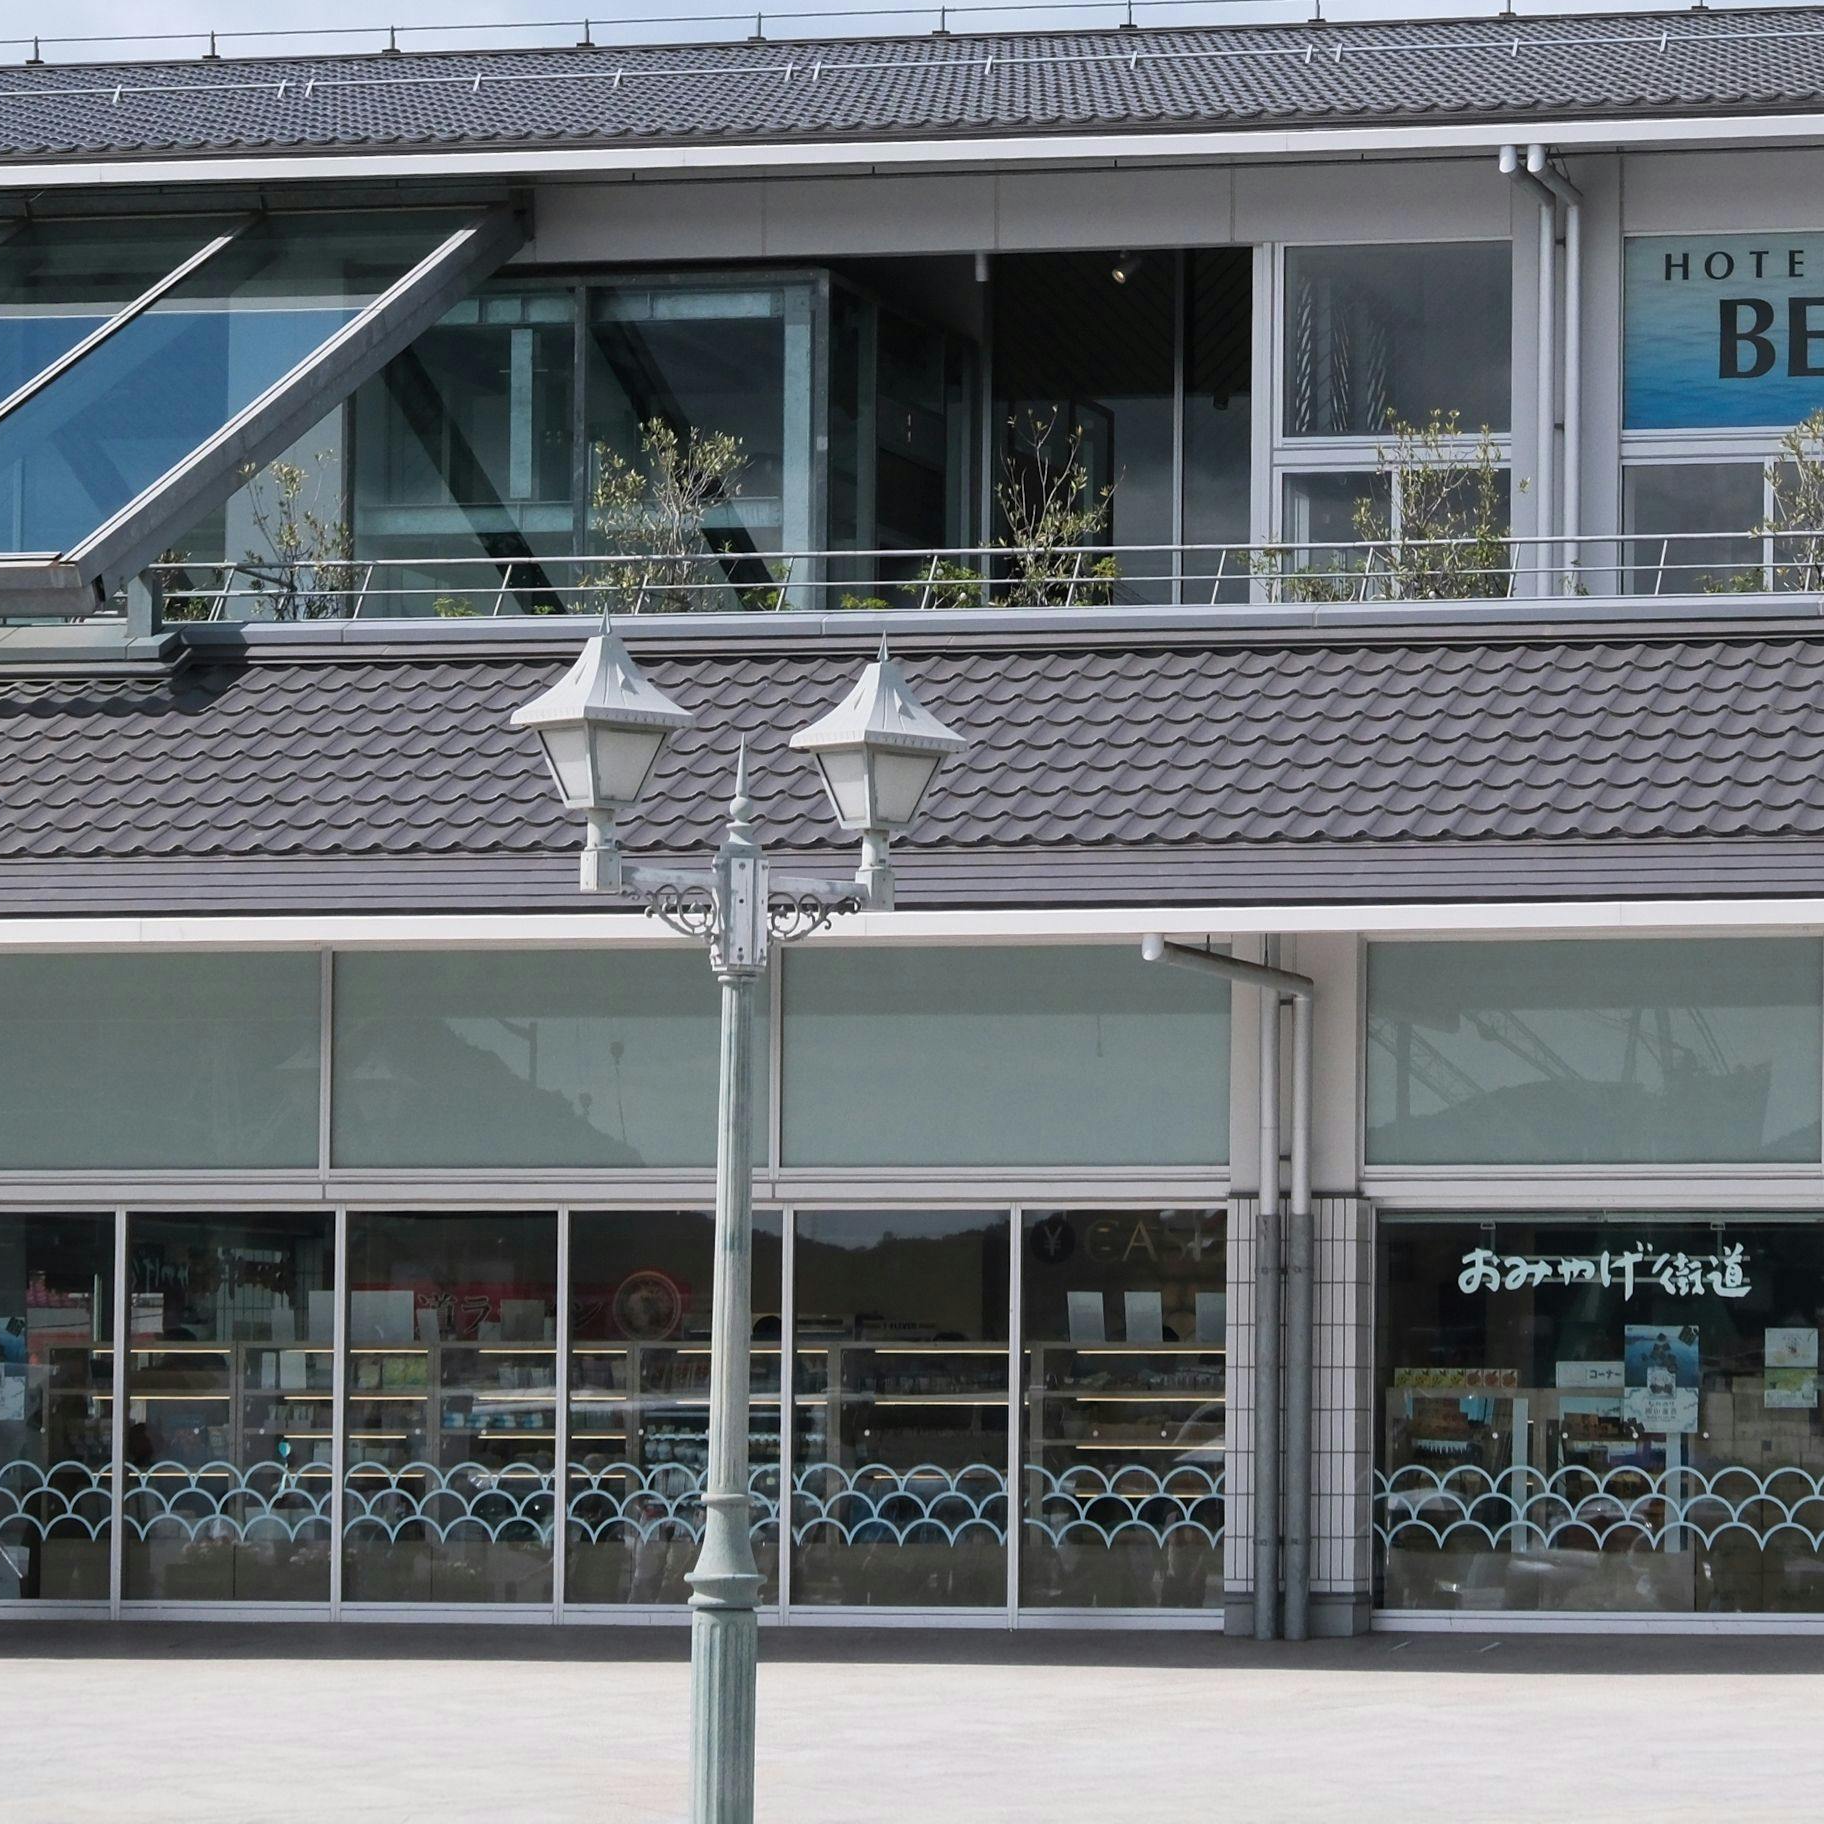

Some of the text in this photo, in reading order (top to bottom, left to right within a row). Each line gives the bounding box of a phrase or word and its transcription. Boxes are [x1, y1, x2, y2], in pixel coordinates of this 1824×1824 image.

[1457, 1240, 1753, 1302] おみやげ街道
